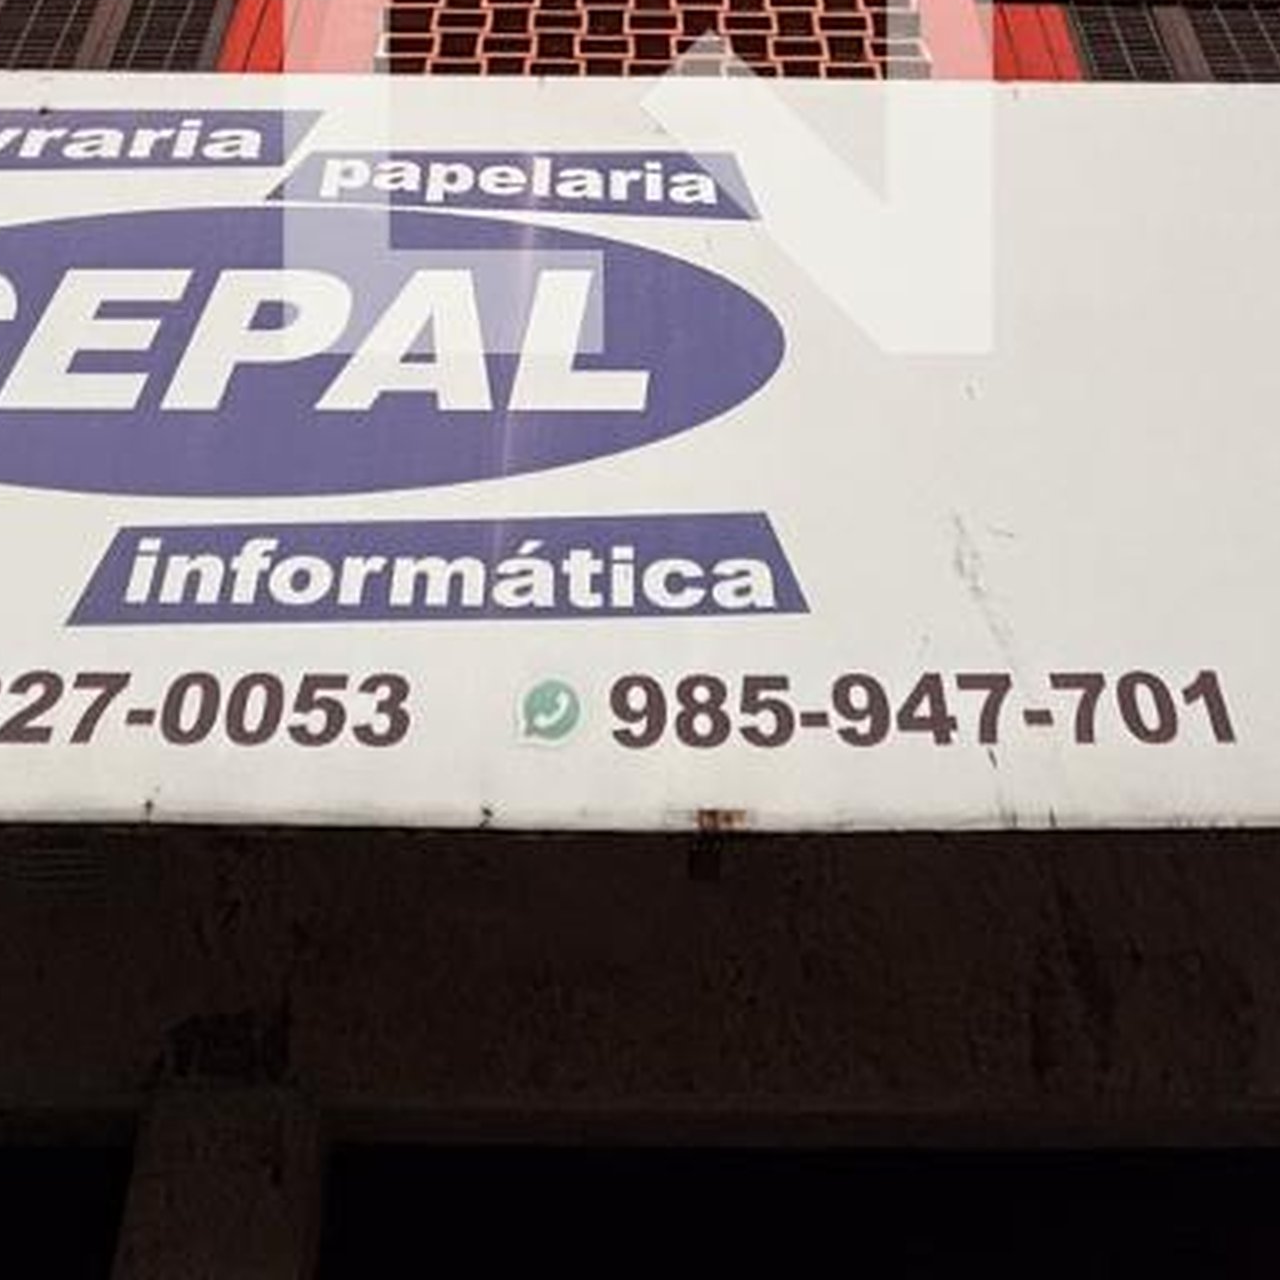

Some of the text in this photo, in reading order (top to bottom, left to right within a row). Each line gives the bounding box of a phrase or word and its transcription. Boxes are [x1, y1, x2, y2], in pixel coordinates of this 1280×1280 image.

[318, 156, 718, 205] papelaria
[125, 537, 777, 609] informática
[608, 669, 1237, 749] 985-947-701
